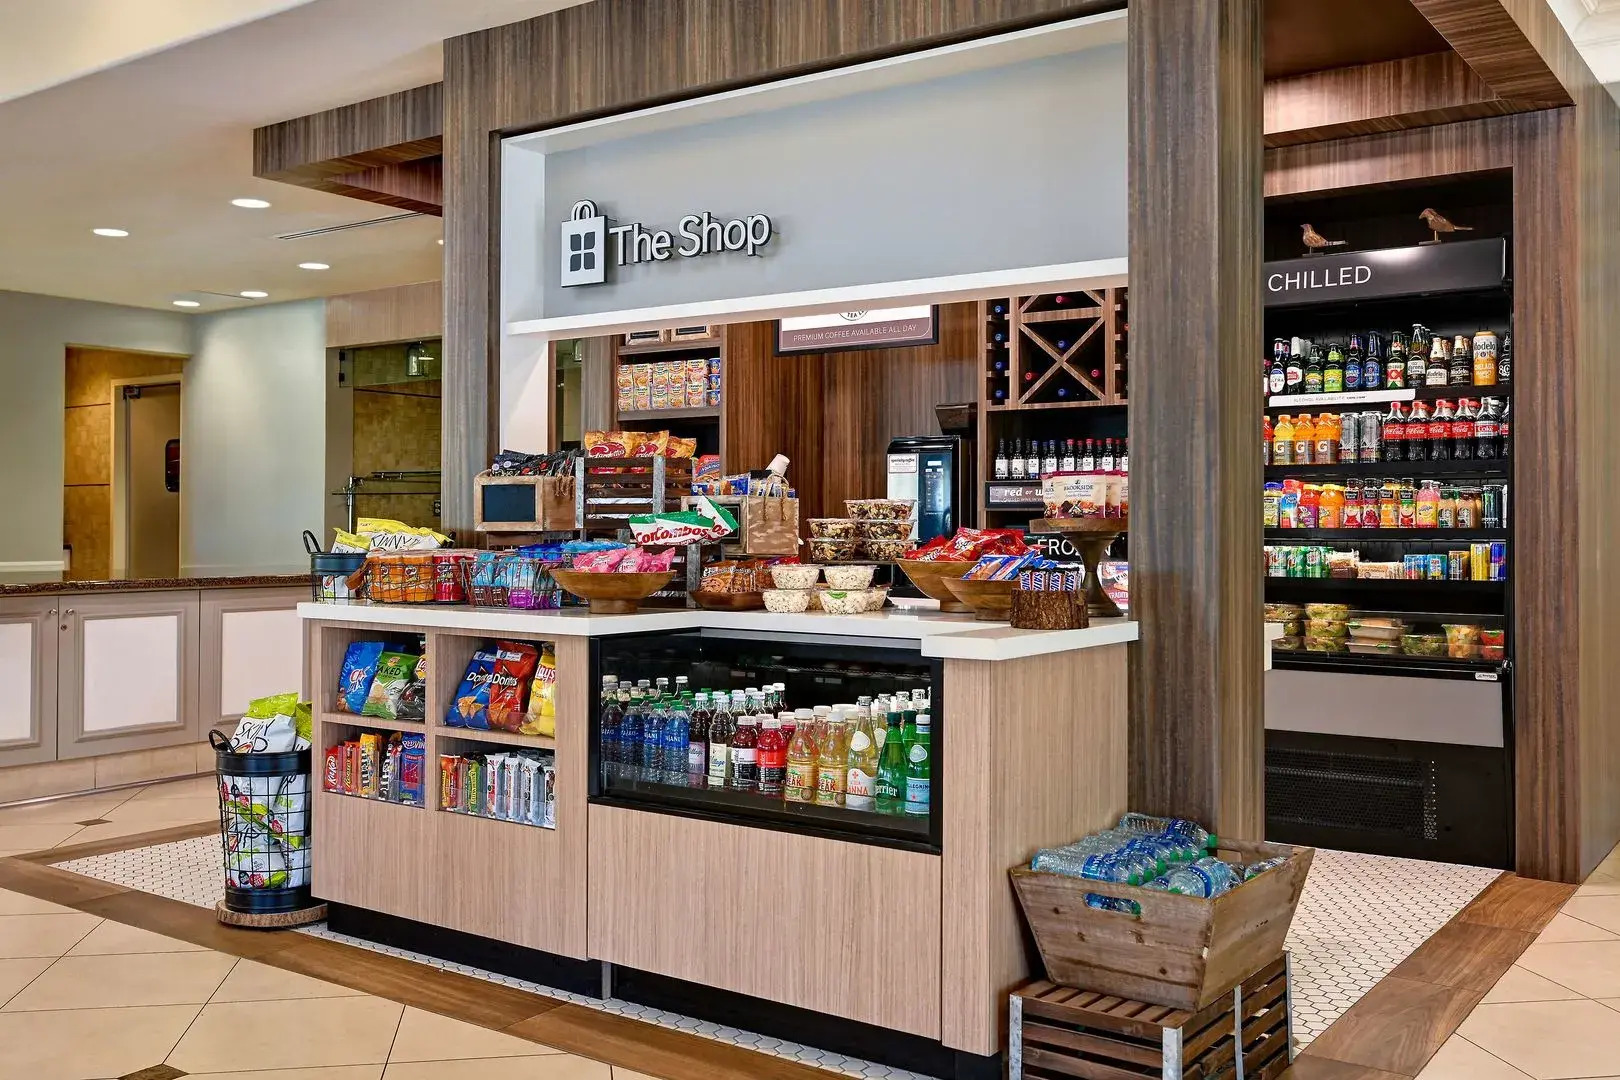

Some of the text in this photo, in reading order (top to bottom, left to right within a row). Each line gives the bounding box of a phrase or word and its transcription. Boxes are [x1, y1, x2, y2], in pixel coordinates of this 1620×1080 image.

[609, 211, 772, 266] The Shop
[1268, 265, 1372, 292] CHILLED
[793, 323, 917, 342] PREMIUM COFFEE AVAILABLE ALL DAY
[1004, 487, 1022, 497] red
[656, 525, 709, 540] Combos
[493, 673, 518, 686] Doritos
